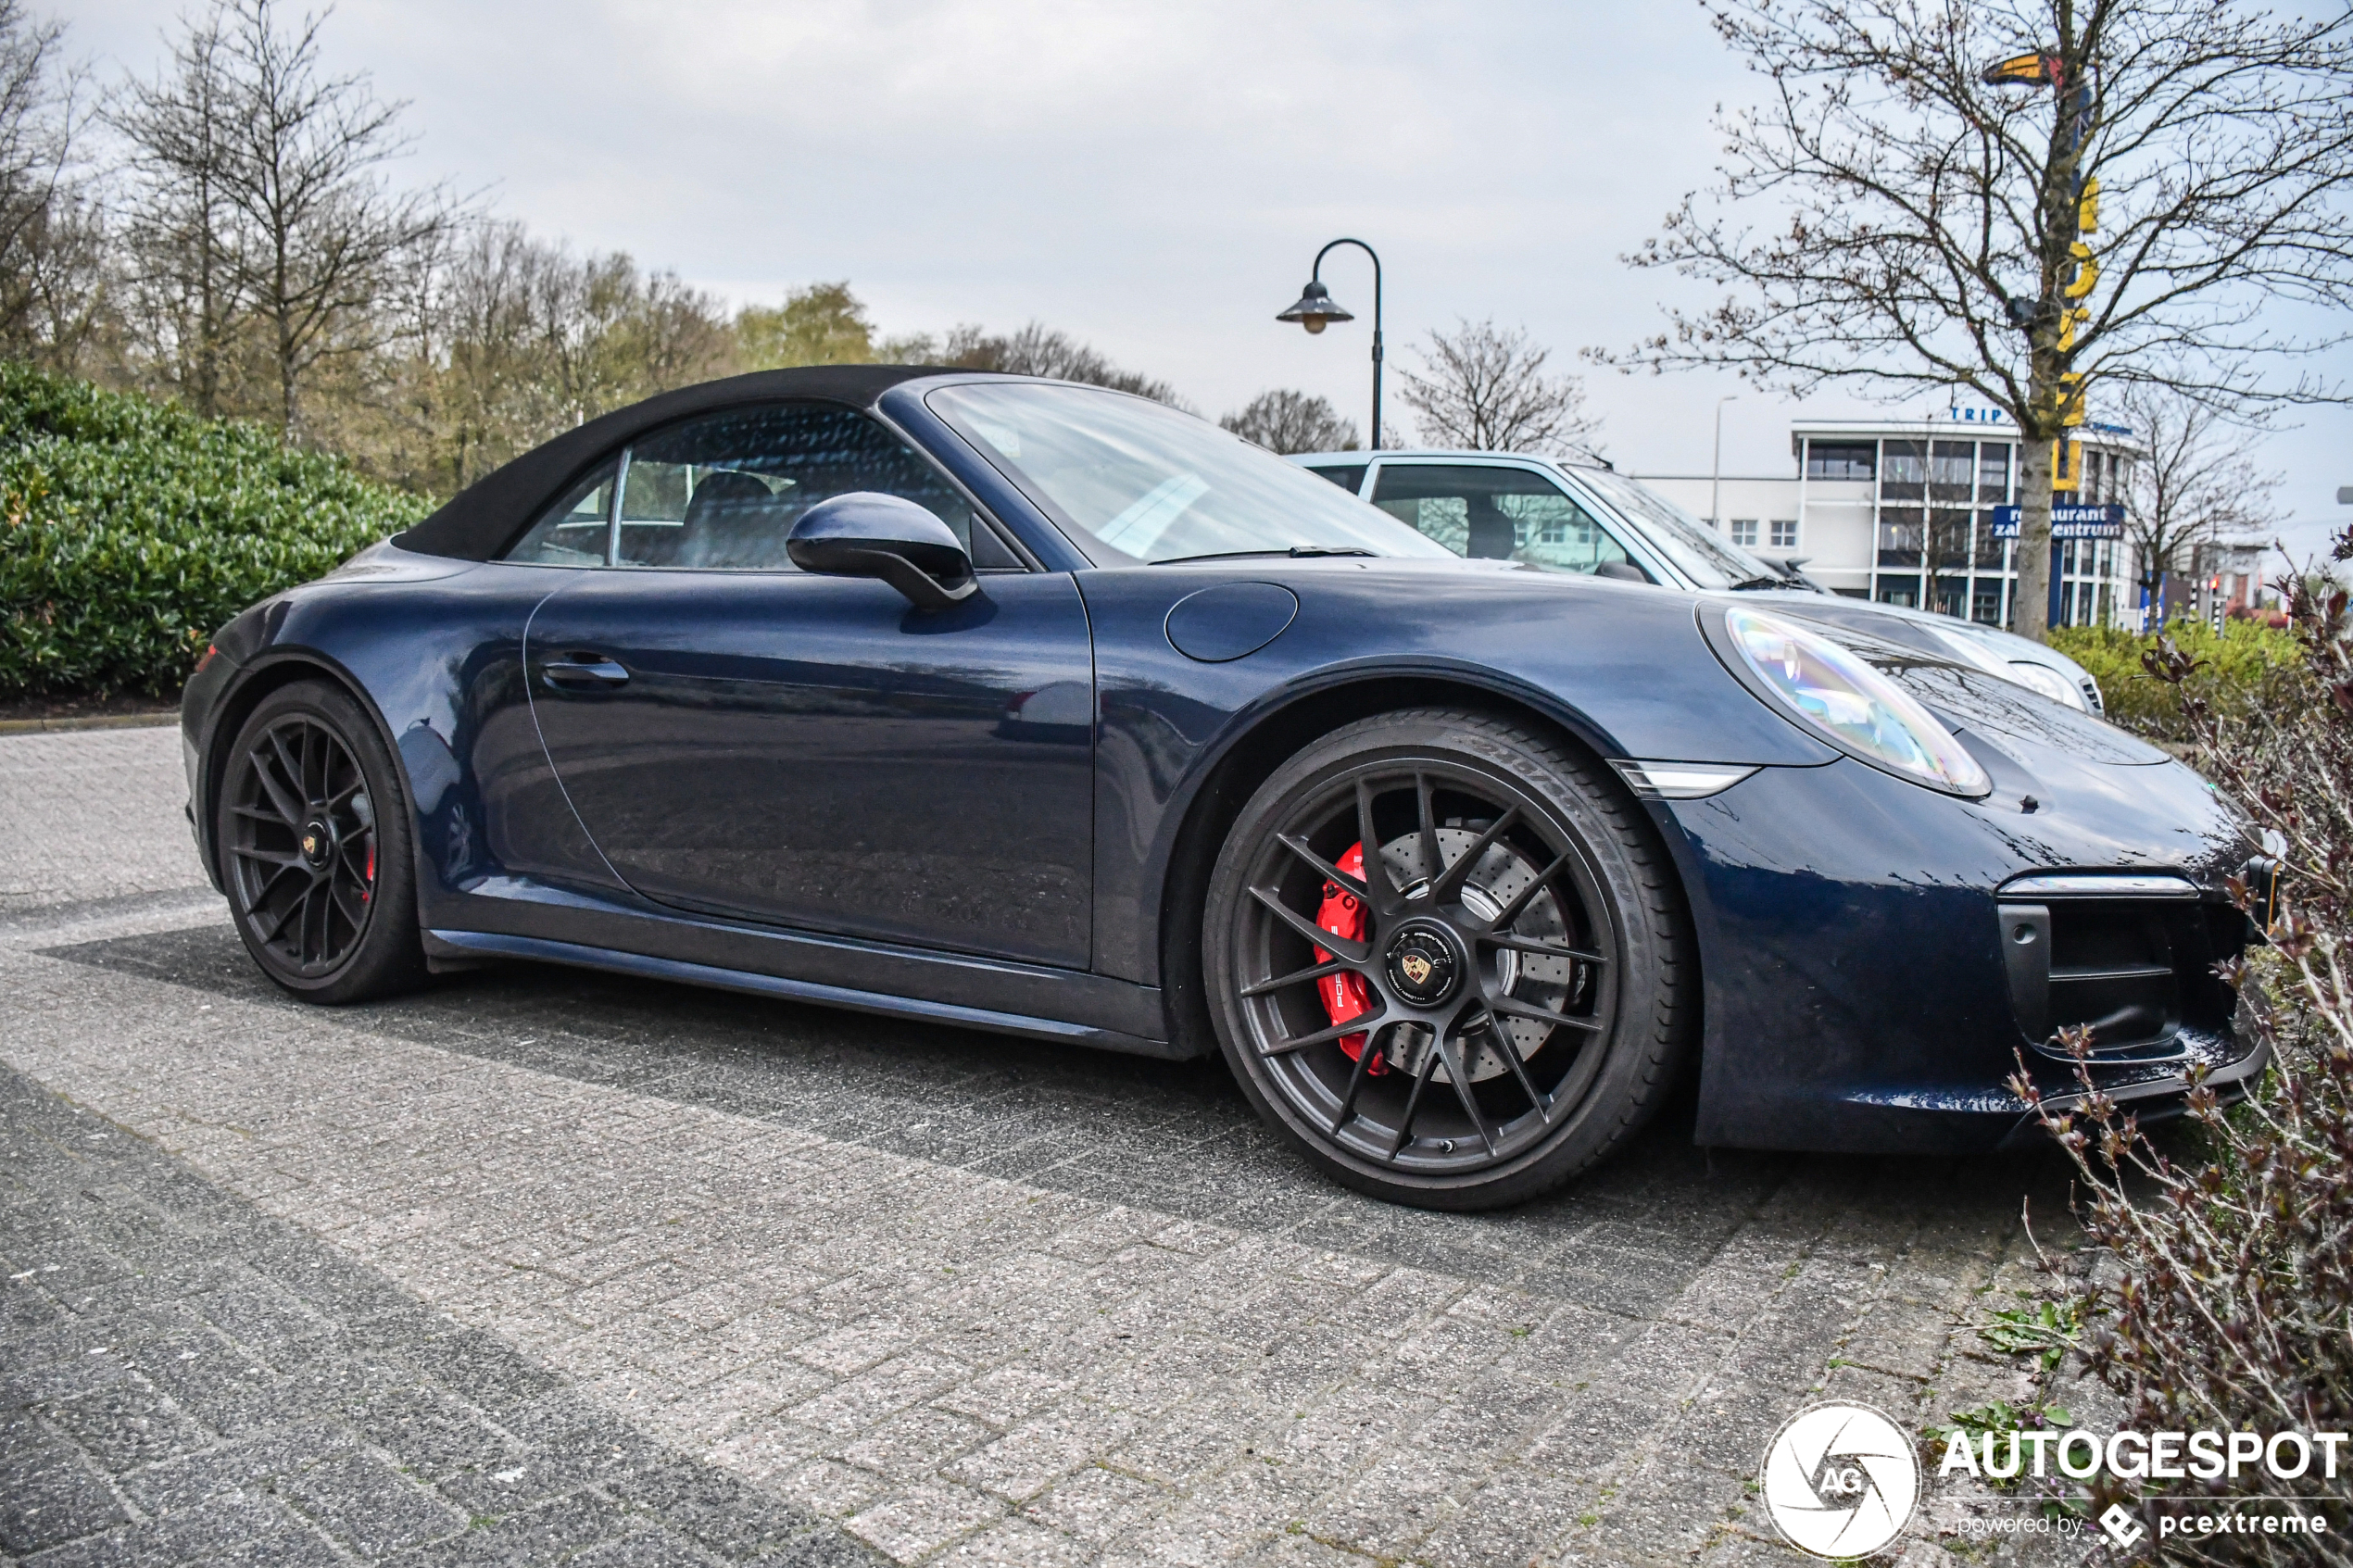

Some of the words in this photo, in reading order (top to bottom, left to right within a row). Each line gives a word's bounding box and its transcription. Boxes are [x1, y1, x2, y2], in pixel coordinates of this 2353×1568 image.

[1951, 408, 2001, 421] TRIP
[2009, 507, 2108, 521] rurant
[1994, 521, 2120, 537] zalentrum
